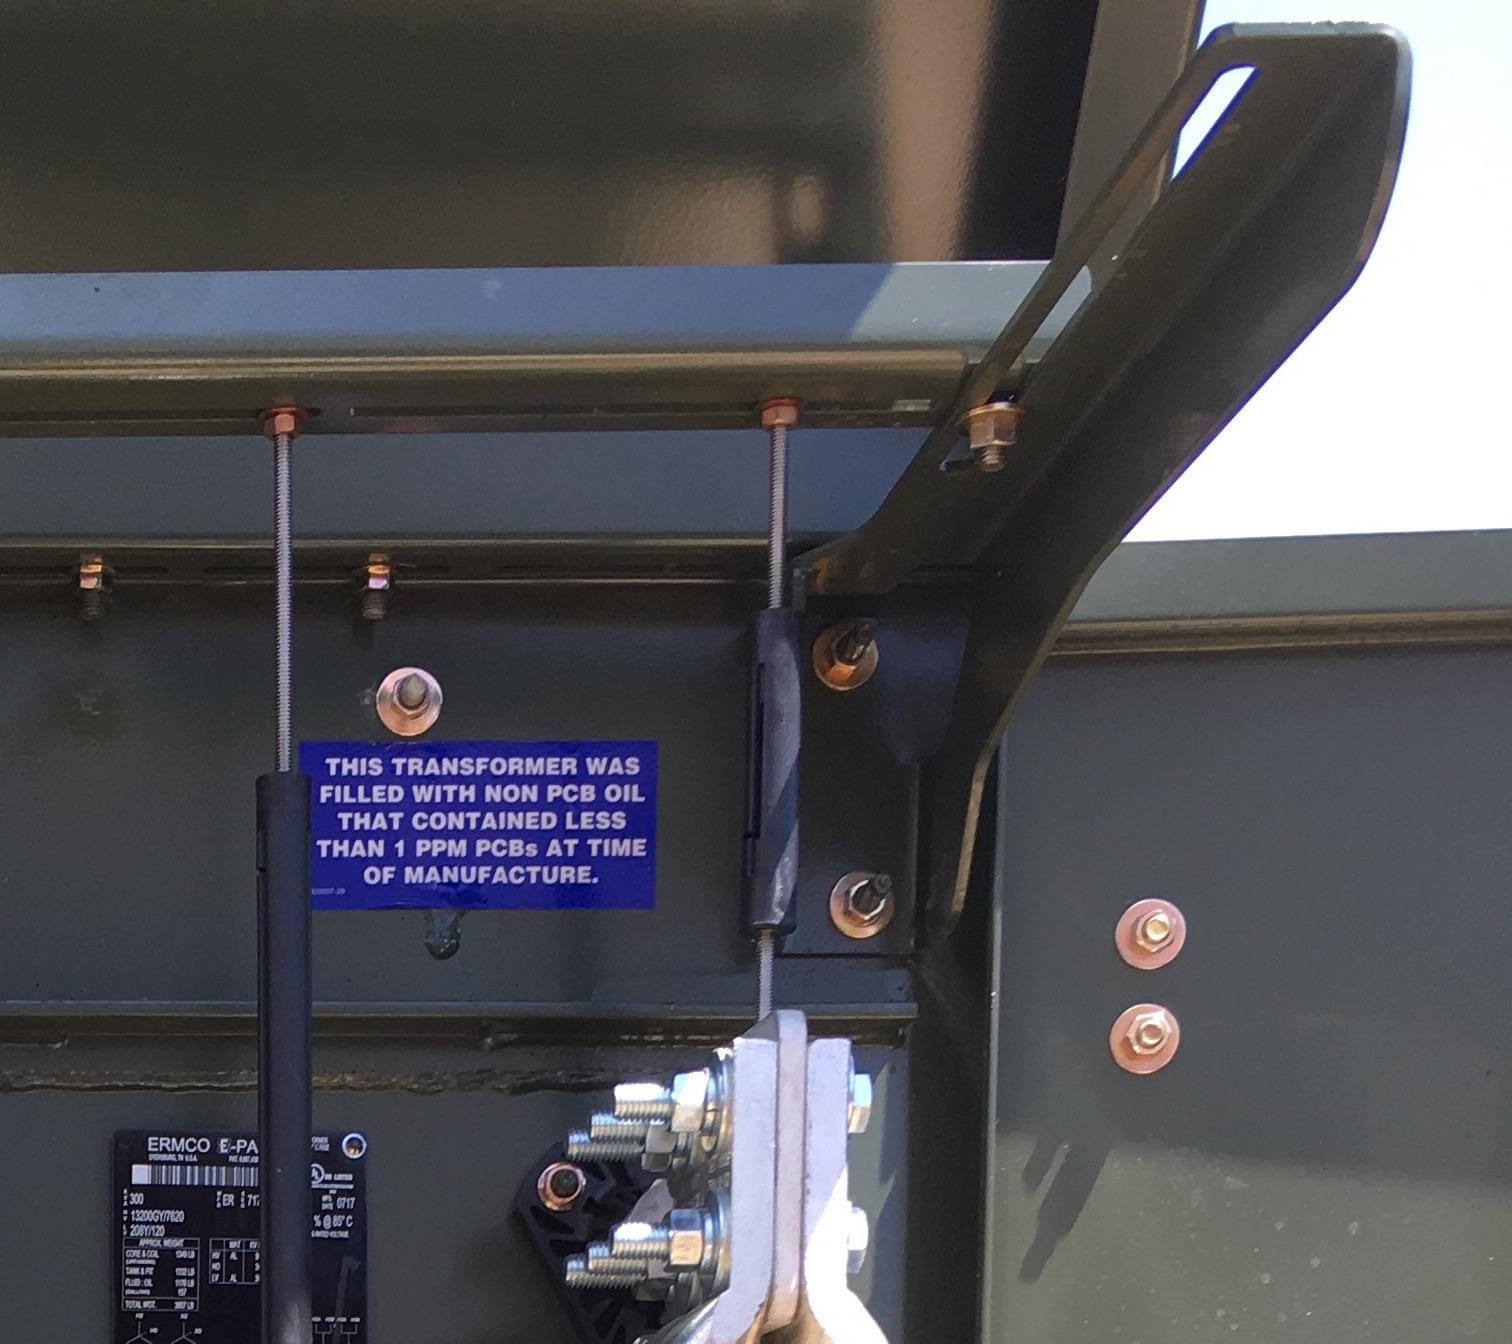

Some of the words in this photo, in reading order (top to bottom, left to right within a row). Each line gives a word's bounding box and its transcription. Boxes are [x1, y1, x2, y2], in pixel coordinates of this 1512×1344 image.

[325, 757, 384, 776] THIS
[391, 757, 578, 776] TRANSFORMER
[585, 757, 641, 775] WAS
[319, 784, 405, 803] FILLED
[412, 784, 476, 803] WITH
[484, 784, 539, 803] NON
[546, 784, 596, 803] PCB
[603, 784, 646, 803] OIL
[337, 811, 403, 830] THAT
[411, 811, 558, 830] CONTAINED
[564, 811, 628, 830] LESS
[316, 839, 385, 858] THAN
[394, 839, 405, 857] 1
[415, 839, 467, 858] PPM
[475, 839, 538, 858] PCBs
[545, 839, 581, 857] AT
[586, 838, 647, 857] TIME
[363, 866, 396, 885] OF
[404, 866, 599, 885] MANUFACTURE.
[147, 1136, 211, 1153] ERMCO
